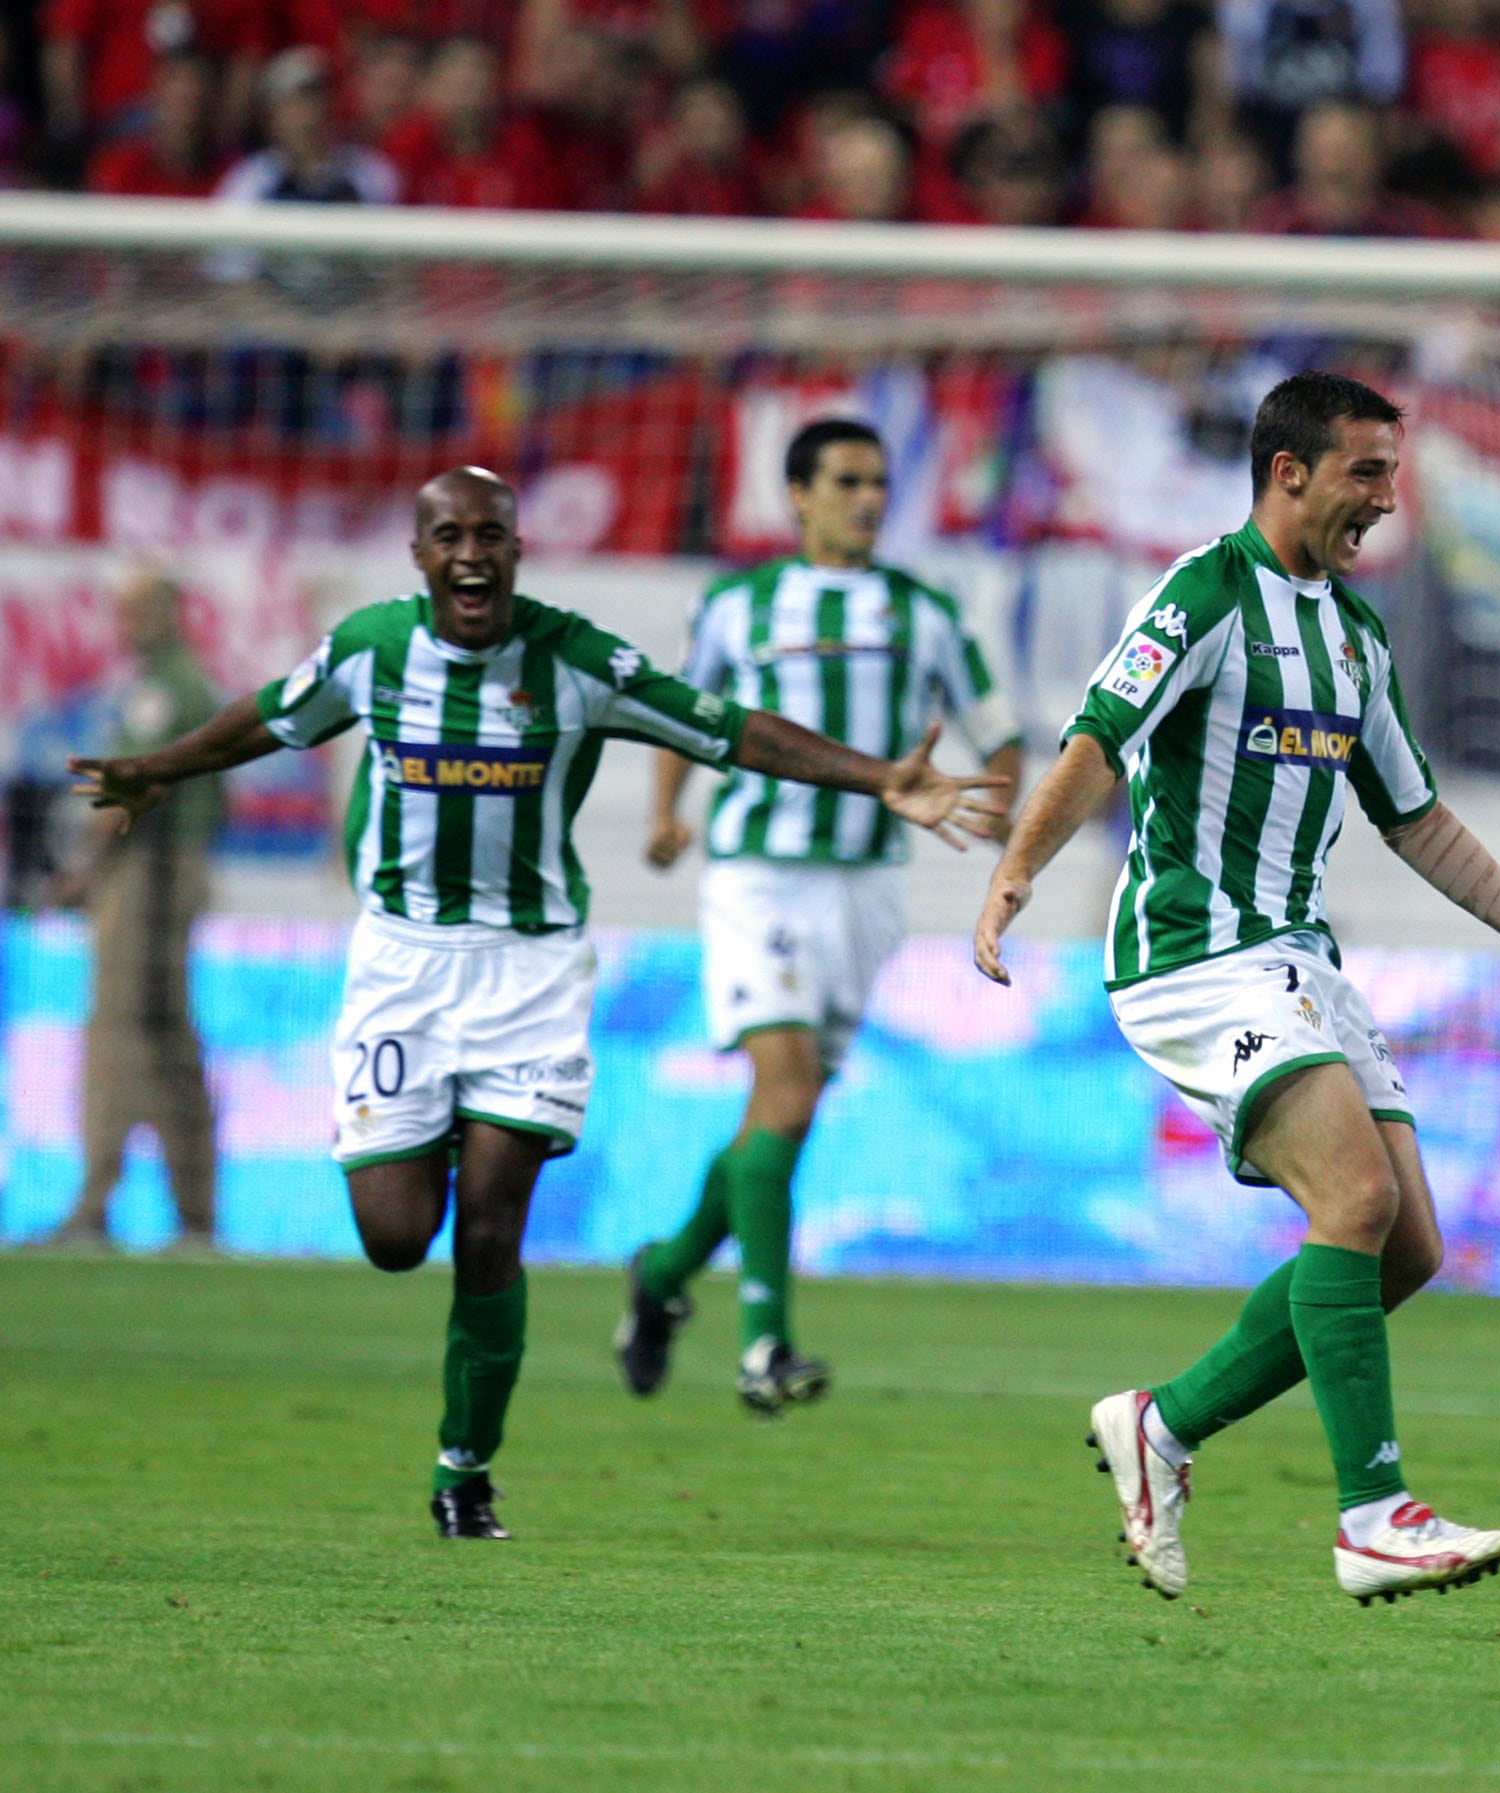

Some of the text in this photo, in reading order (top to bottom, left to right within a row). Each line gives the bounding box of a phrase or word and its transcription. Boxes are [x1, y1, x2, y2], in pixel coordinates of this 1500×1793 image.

[1251, 643, 1300, 658] Kappa
[1112, 677, 1138, 695] LFP
[1280, 727, 1308, 756] EL
[402, 757, 545, 788] EL MONTE
[1264, 963, 1300, 993] 7
[346, 1038, 404, 1104] 20
